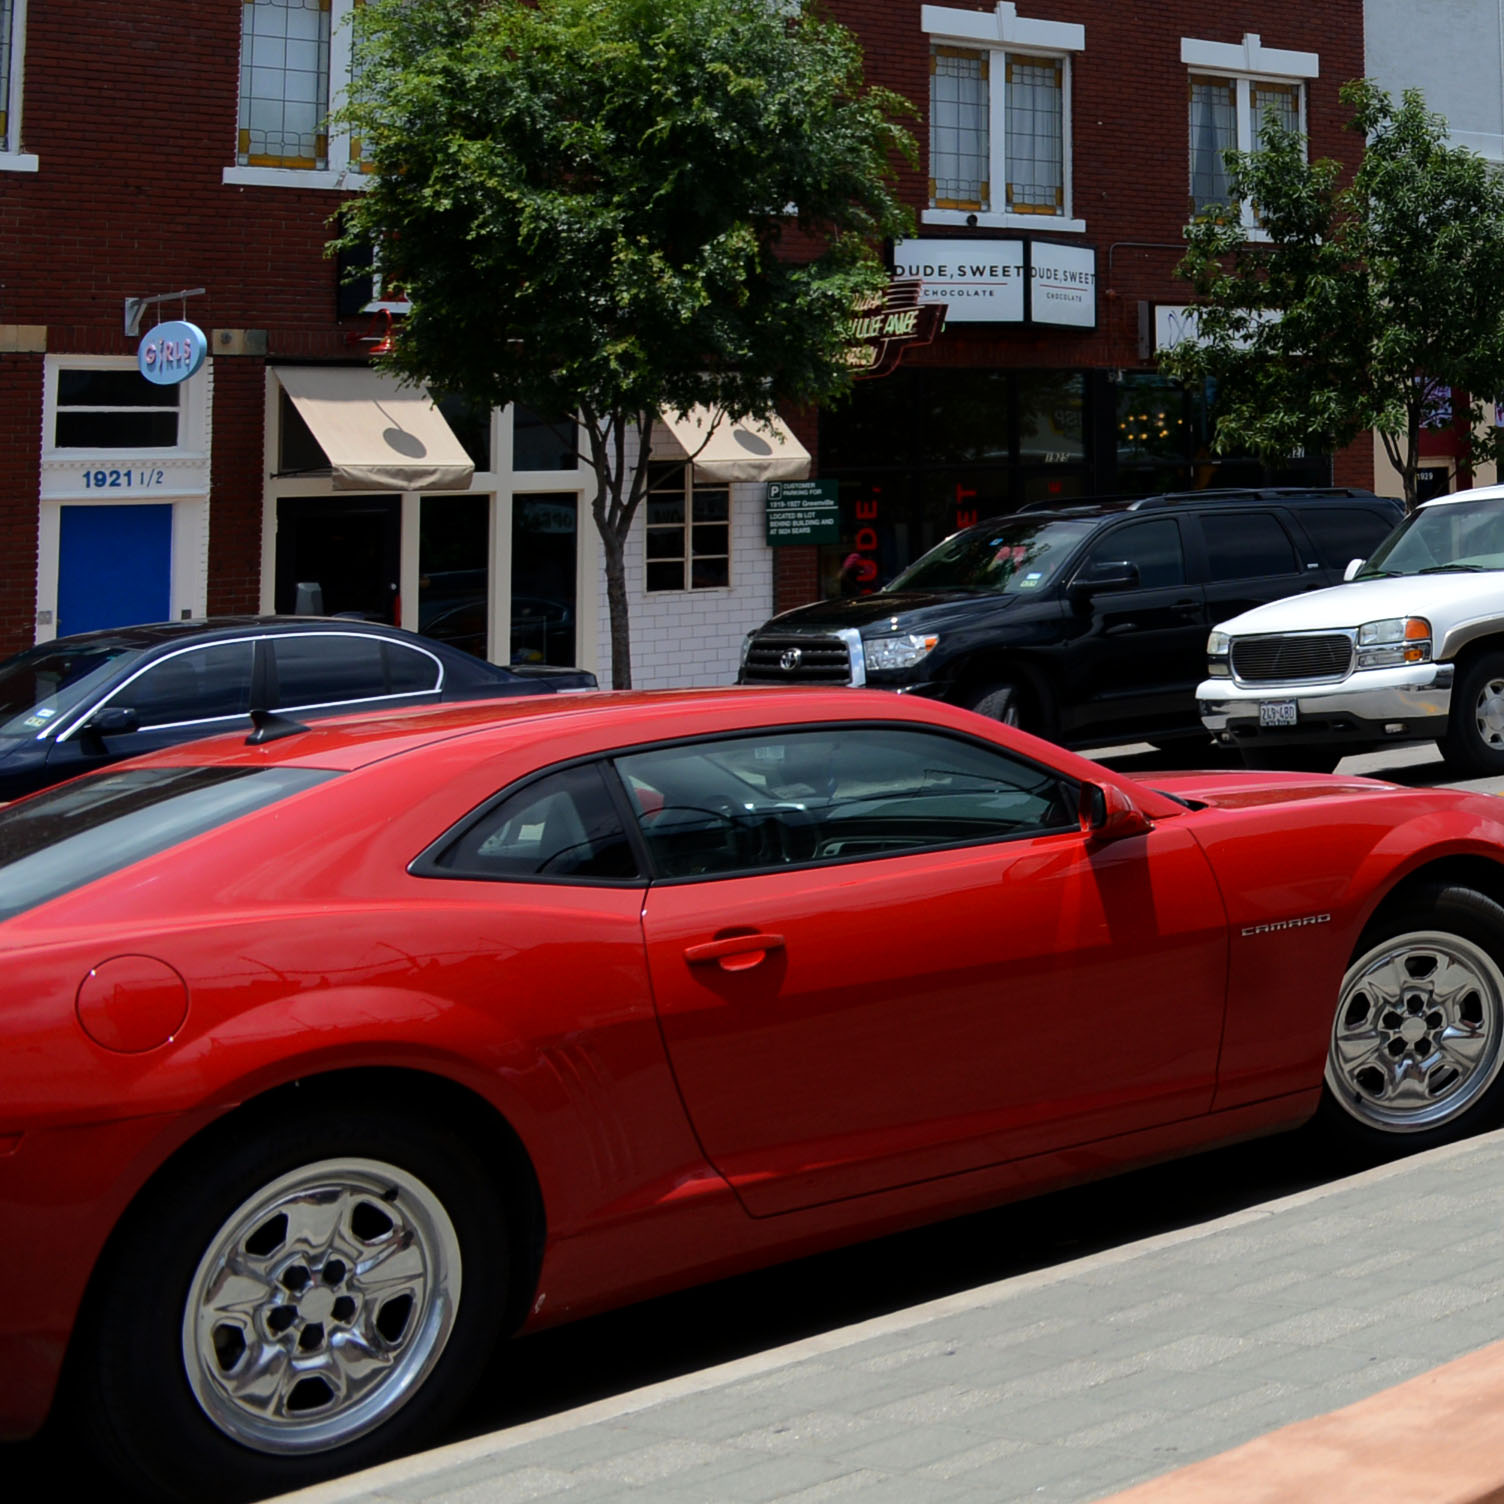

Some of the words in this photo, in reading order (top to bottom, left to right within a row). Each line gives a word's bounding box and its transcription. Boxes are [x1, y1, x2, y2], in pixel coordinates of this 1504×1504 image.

[923, 289, 995, 297] CHOCOLATE
[1046, 292, 1083, 302] CHOCOLATE
[82, 470, 132, 488] 1921
[140, 468, 164, 487] 1/2
[1241, 913, 1331, 937] CAMARO
